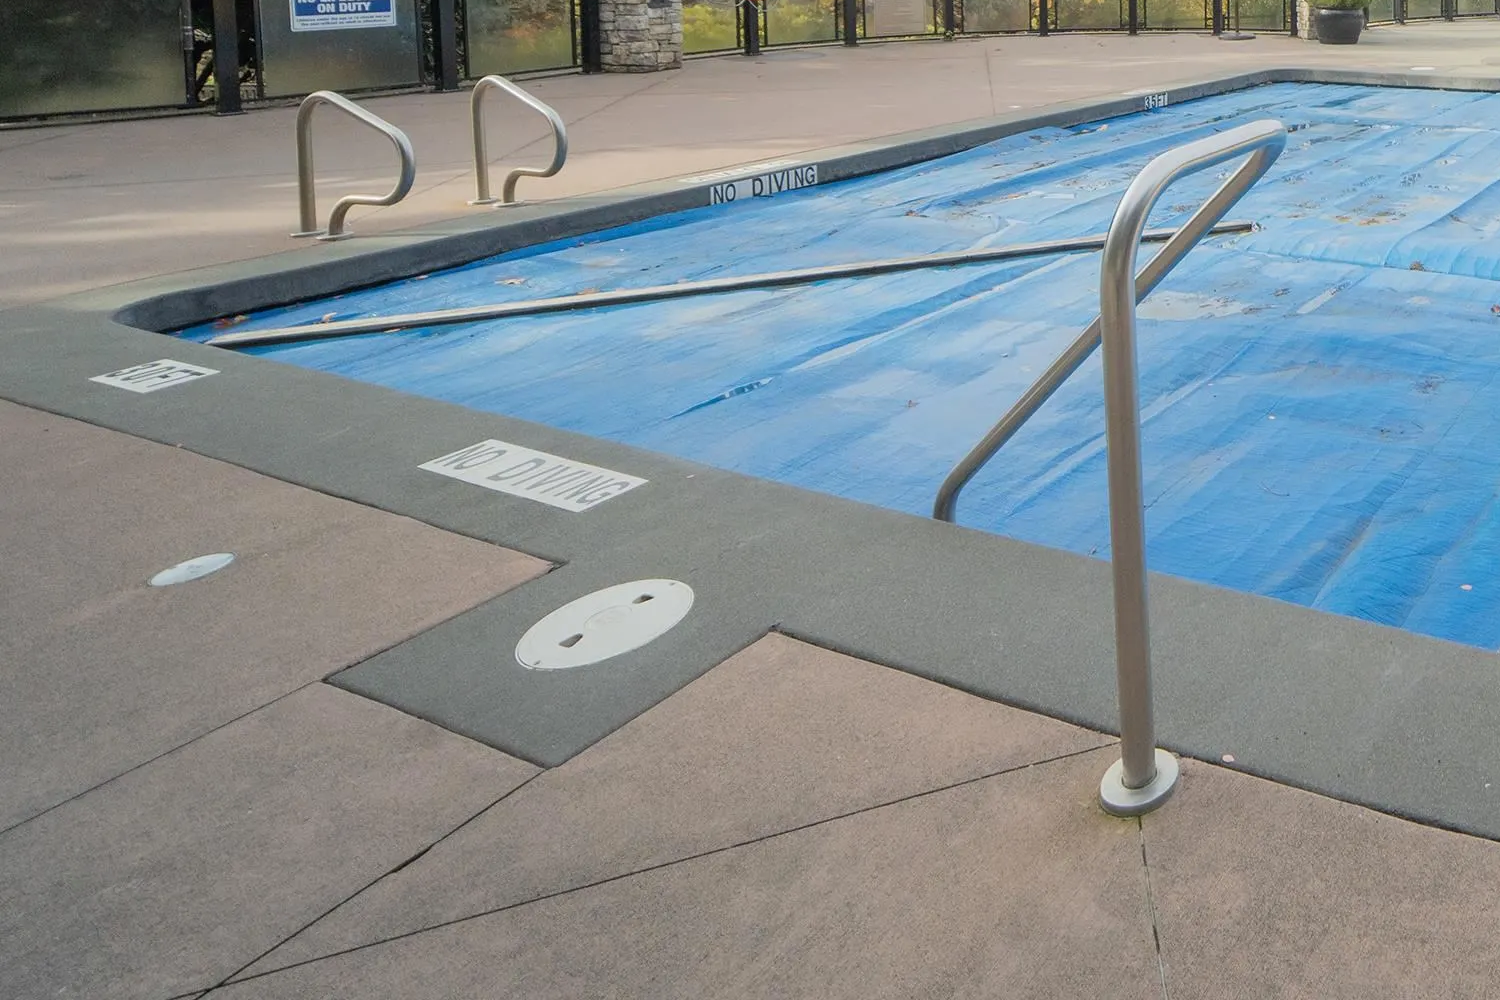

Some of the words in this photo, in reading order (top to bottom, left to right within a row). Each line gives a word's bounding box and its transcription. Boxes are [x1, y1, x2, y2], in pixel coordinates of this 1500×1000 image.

[317, 3, 335, 14] ON
[338, 2, 371, 13] DUTY
[712, 183, 737, 204] NO
[751, 166, 816, 197] DIVING
[435, 443, 508, 470] NO
[485, 457, 631, 504] DIVING
